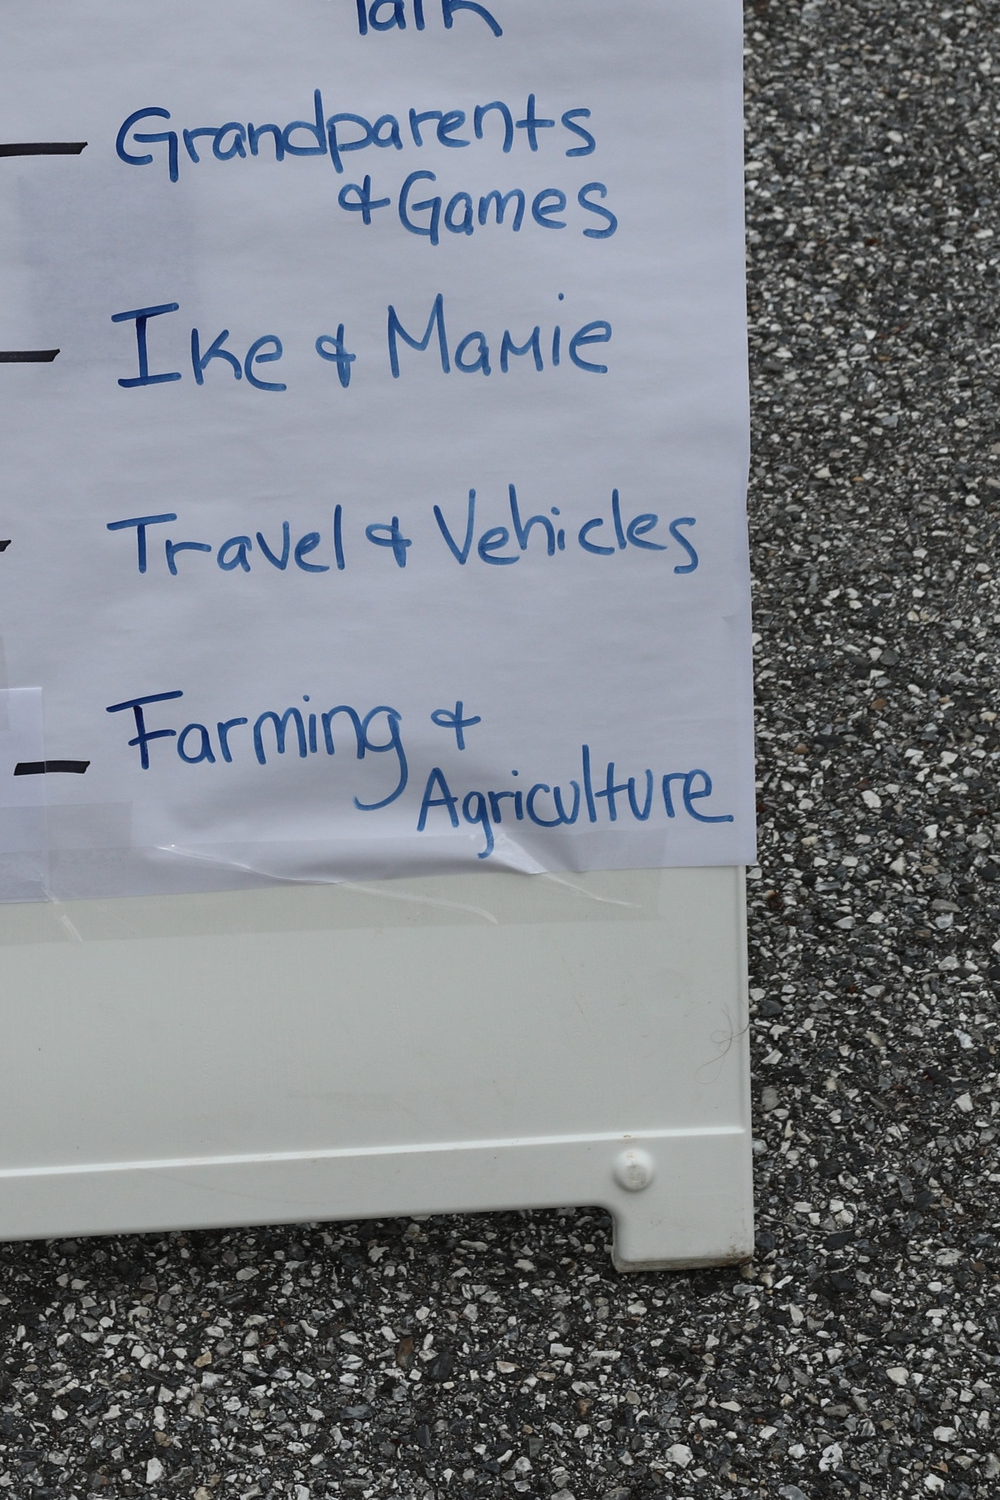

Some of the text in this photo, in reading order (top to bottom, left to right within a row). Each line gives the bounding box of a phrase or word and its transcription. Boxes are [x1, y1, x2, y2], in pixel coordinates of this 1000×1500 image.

[116, 89, 595, 183] Grandparents
[399, 170, 617, 245] Games
[111, 303, 287, 391] Ike
[107, 504, 345, 575] Travel
[433, 484, 698, 574] Vehicles
[106, 690, 408, 810] Farming
[418, 745, 734, 859] Agriculture
